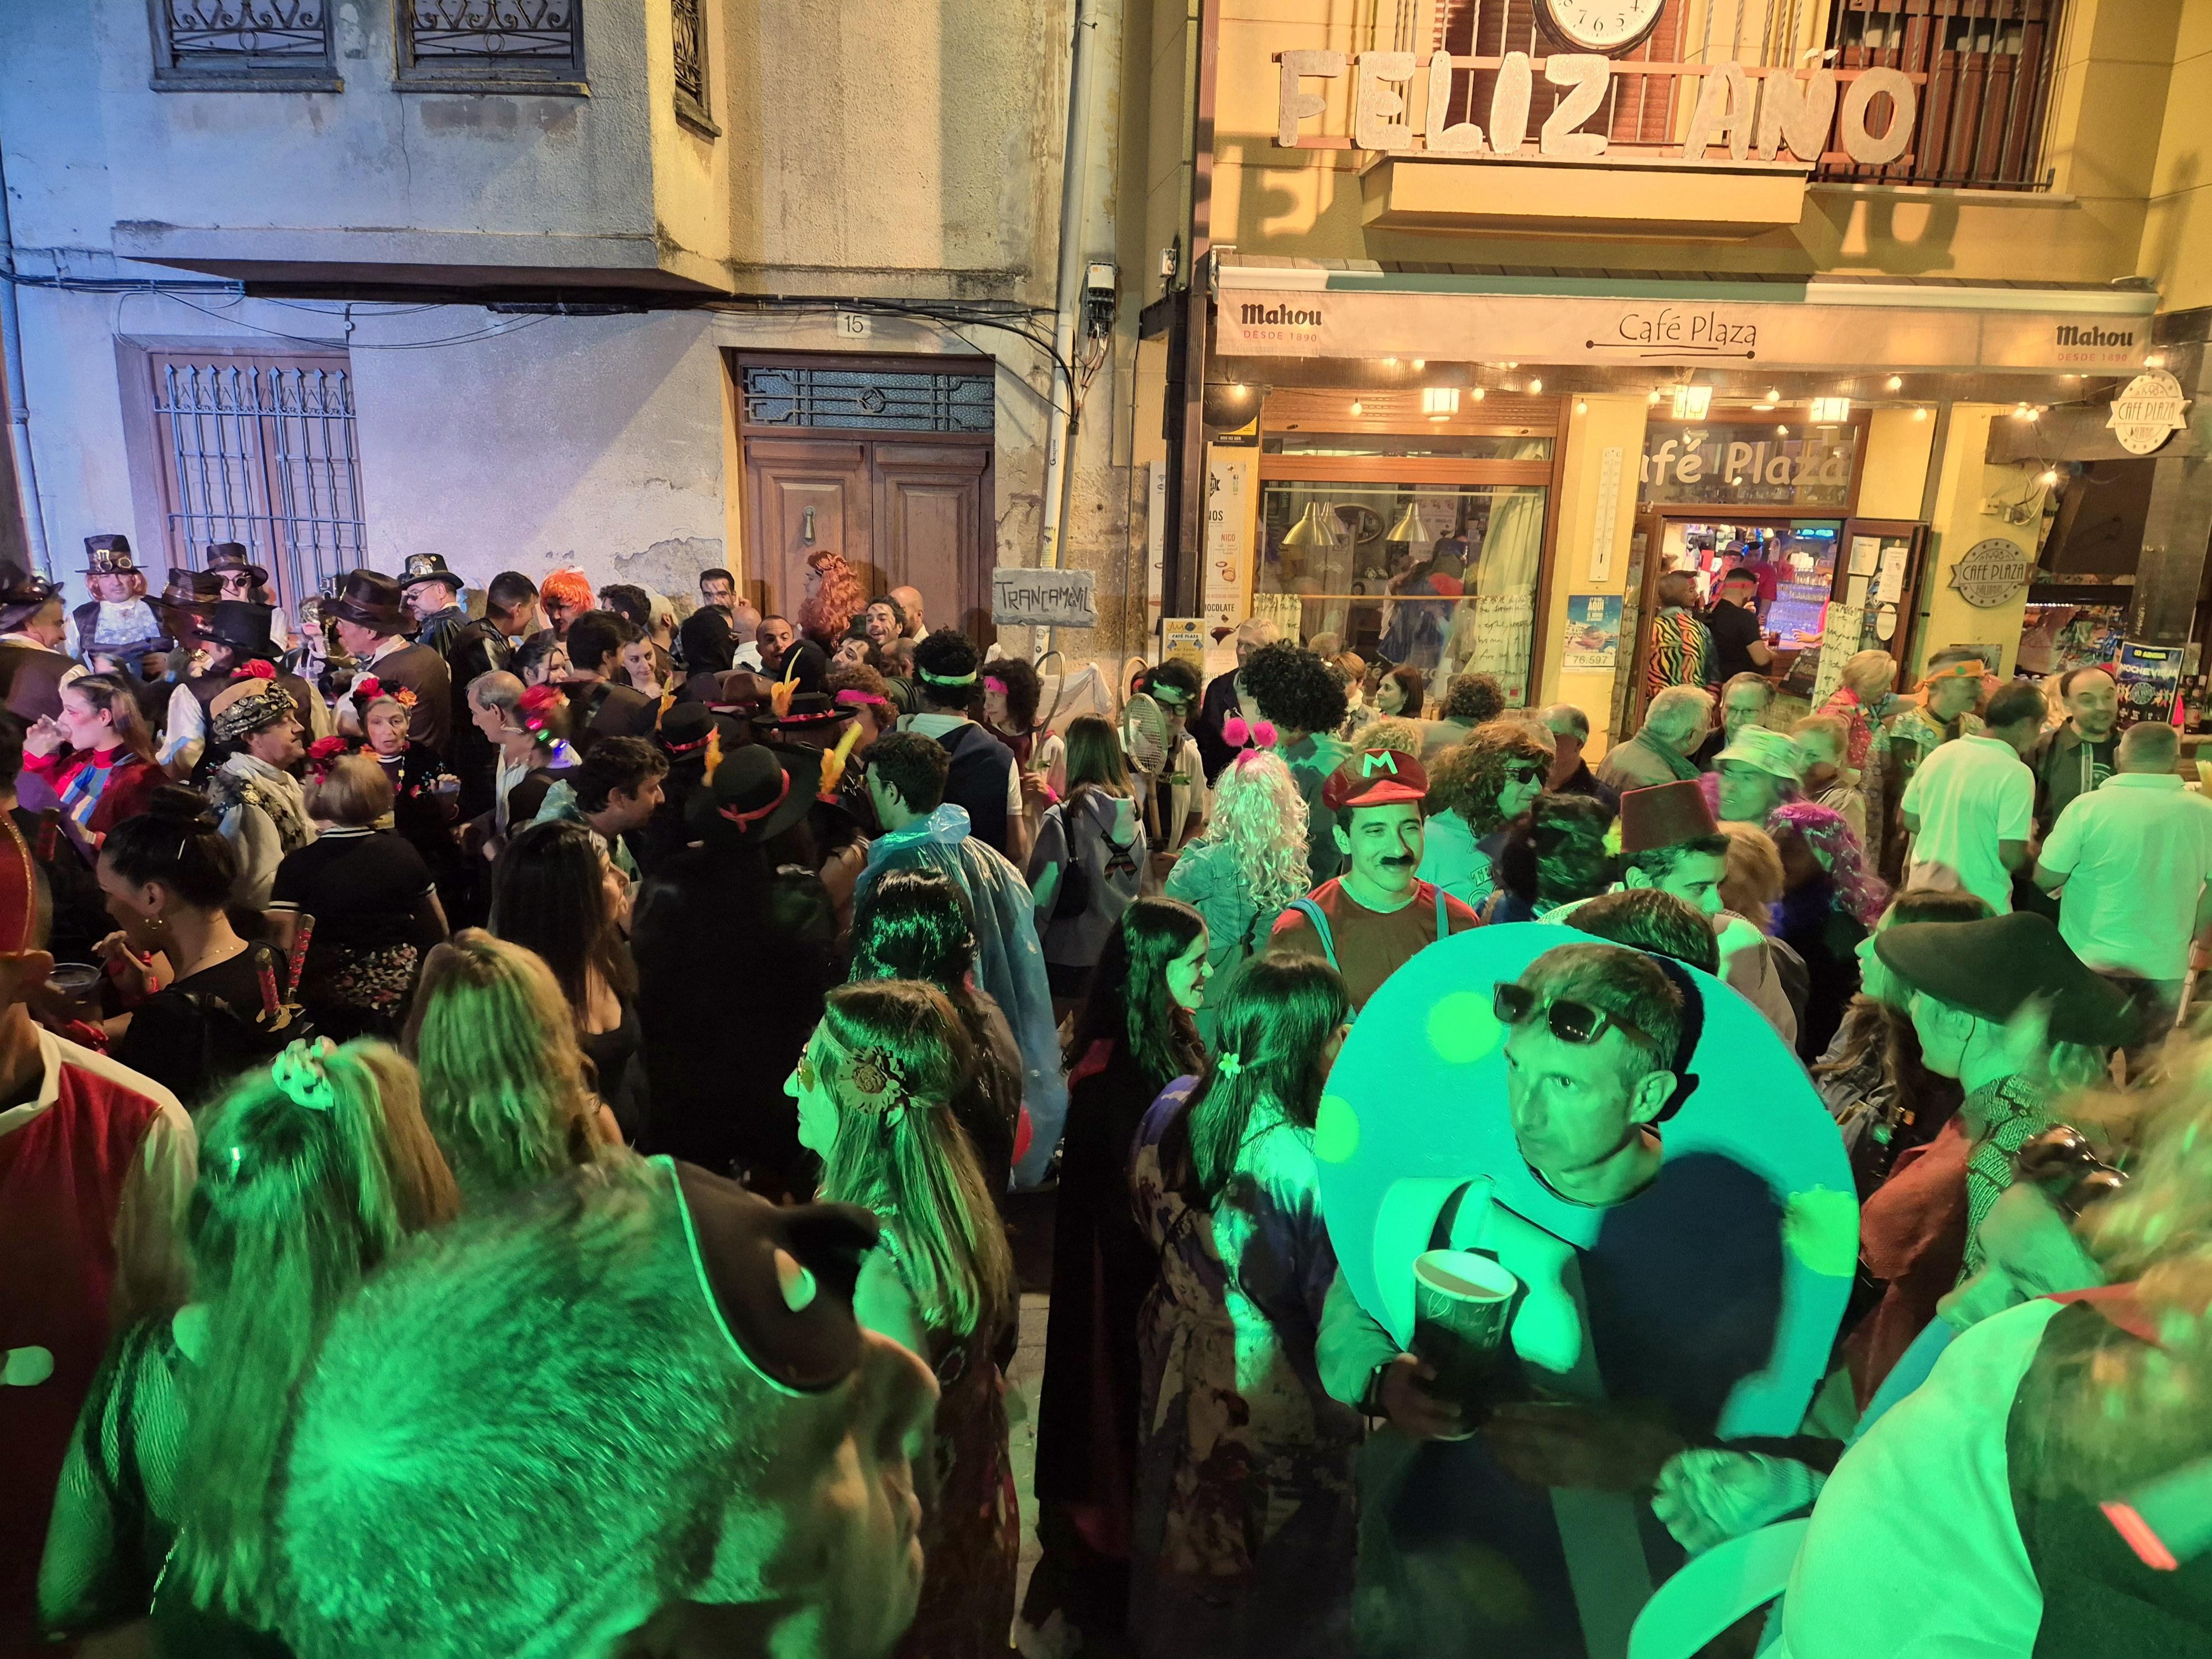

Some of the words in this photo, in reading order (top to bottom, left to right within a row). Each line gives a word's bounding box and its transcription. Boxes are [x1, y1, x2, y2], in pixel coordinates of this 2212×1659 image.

[1278, 49, 1610, 155] FELIZ
[844, 315, 864, 333] 15
[1240, 303, 1322, 326] Mahou
[1243, 330, 1284, 341] DESDE
[1290, 332, 1317, 342] 1890
[1619, 307, 1681, 343] Café
[1691, 311, 1757, 347] Plaza
[2056, 325, 2133, 347] Mahou
[2058, 353, 2095, 362] DESDE
[2103, 353, 2128, 362] 1890
[2145, 402, 2176, 421] PLAZA
[1724, 441, 1847, 486] Plaza
[1221, 533, 1235, 541] NICO
[1991, 564, 2024, 580] PLAZA
[1573, 655, 1608, 665] 76.597
[1362, 750, 1399, 779] M
